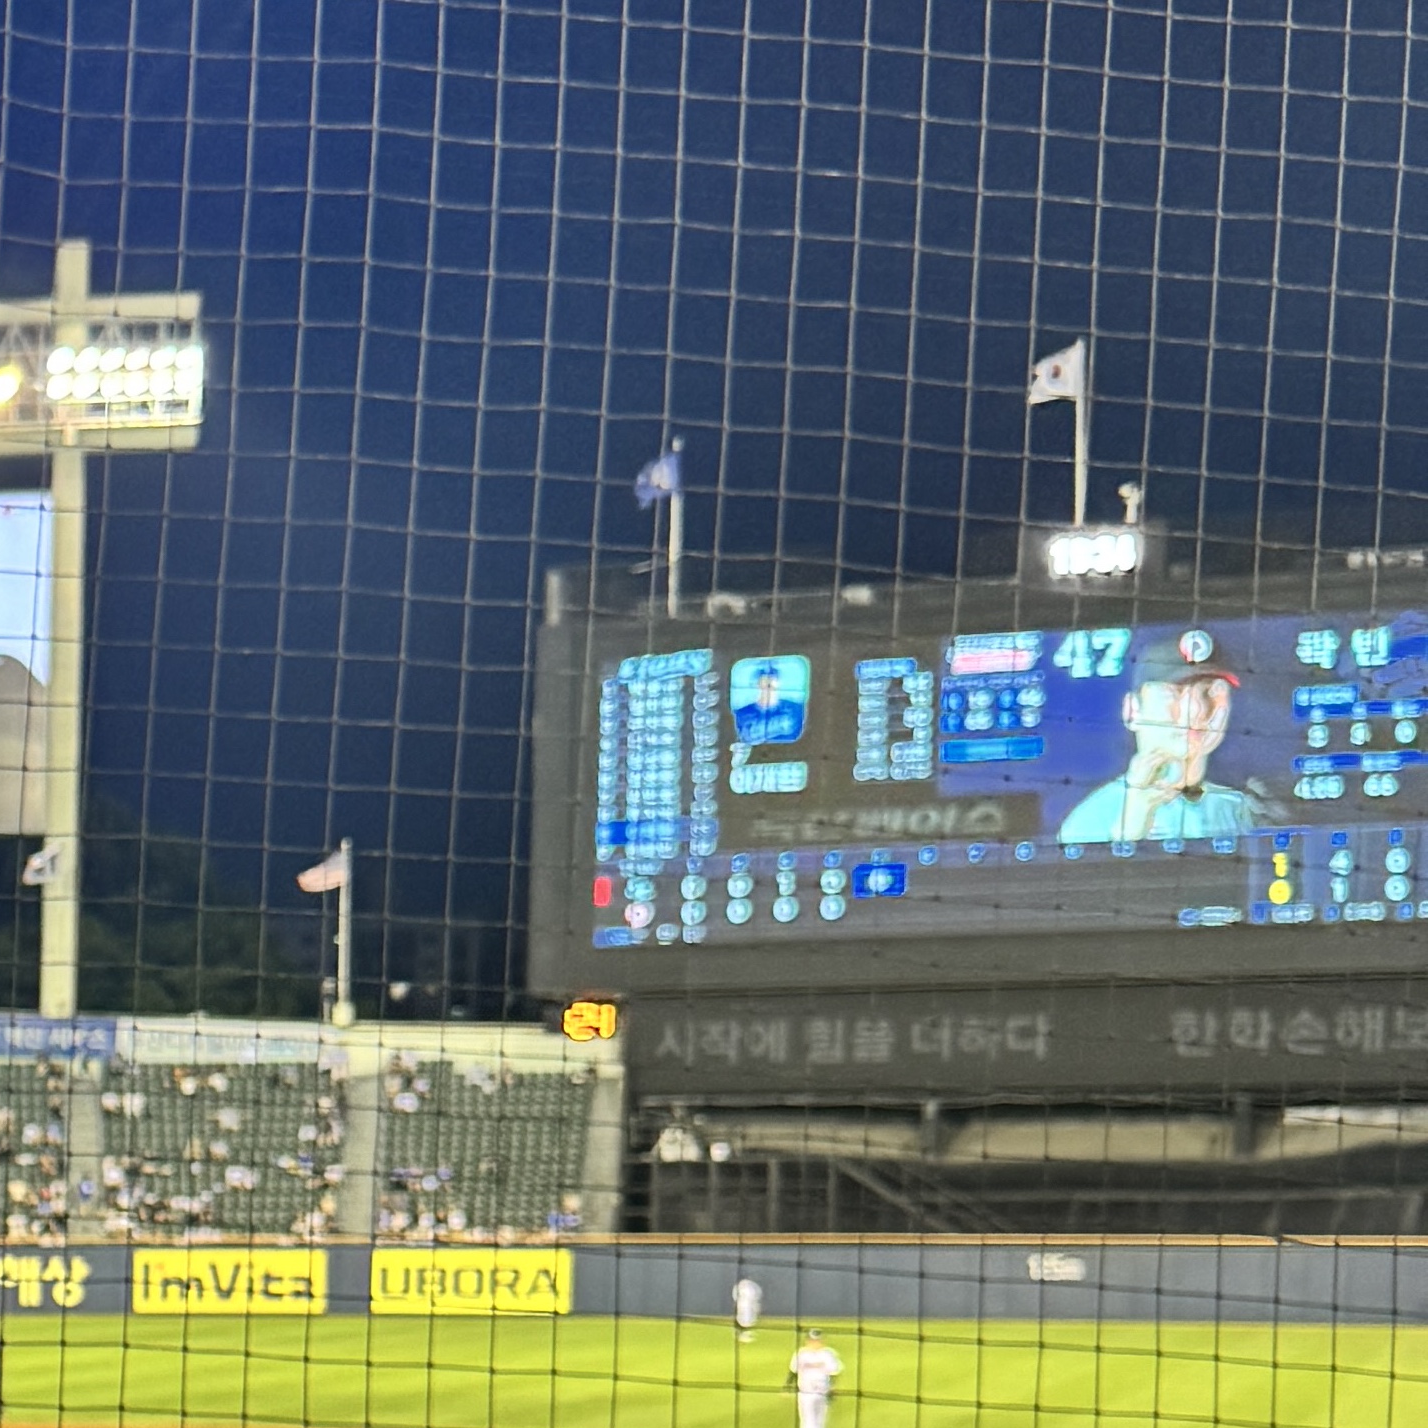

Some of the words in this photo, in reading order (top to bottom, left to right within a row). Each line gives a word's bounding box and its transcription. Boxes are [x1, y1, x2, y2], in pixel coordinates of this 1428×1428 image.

[1053, 628, 1130, 678] 47
[656, 1017, 789, 1065] 시작에
[806, 1017, 895, 1064] 힘을
[910, 1012, 1047, 1063] 더하다
[378, 1266, 561, 1300] UBORA
